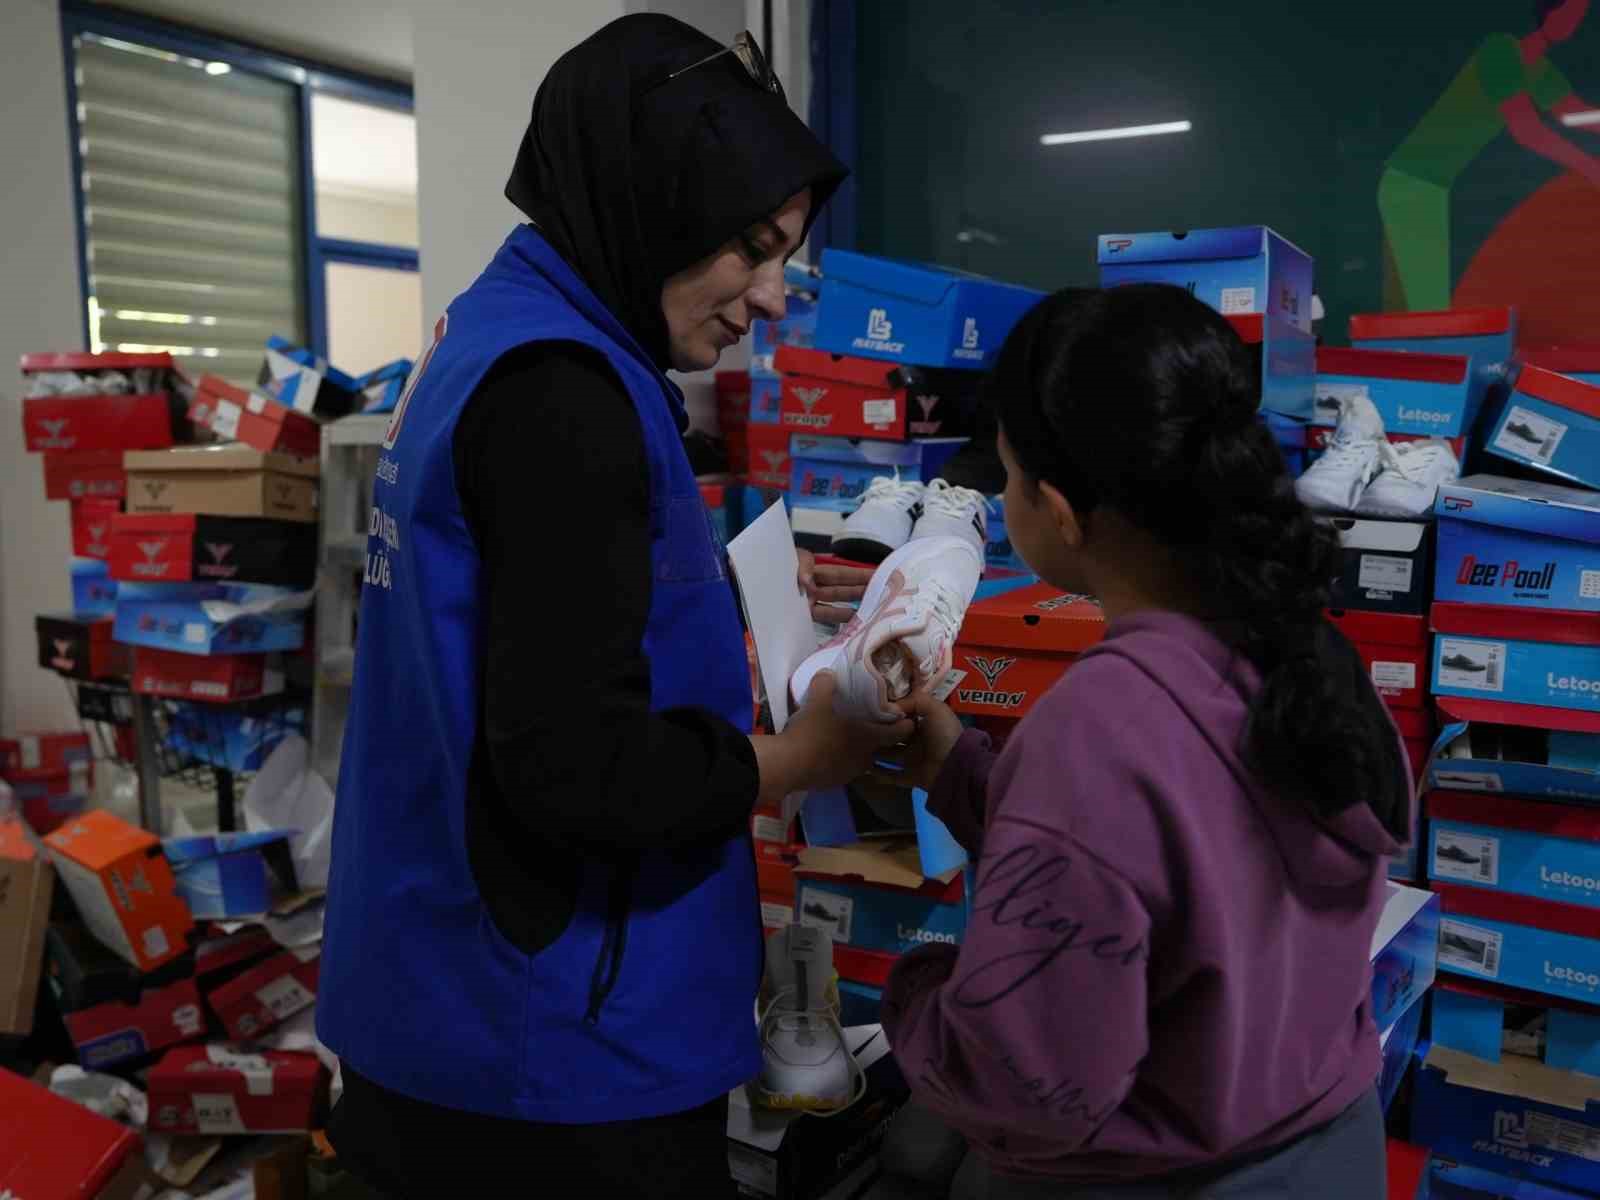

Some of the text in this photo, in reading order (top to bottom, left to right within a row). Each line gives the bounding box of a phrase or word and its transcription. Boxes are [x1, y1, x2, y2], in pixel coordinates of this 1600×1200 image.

[1398, 404, 1450, 424] Letoon
[1456, 554, 1499, 586] Dee
[1502, 560, 1557, 590] Pooll
